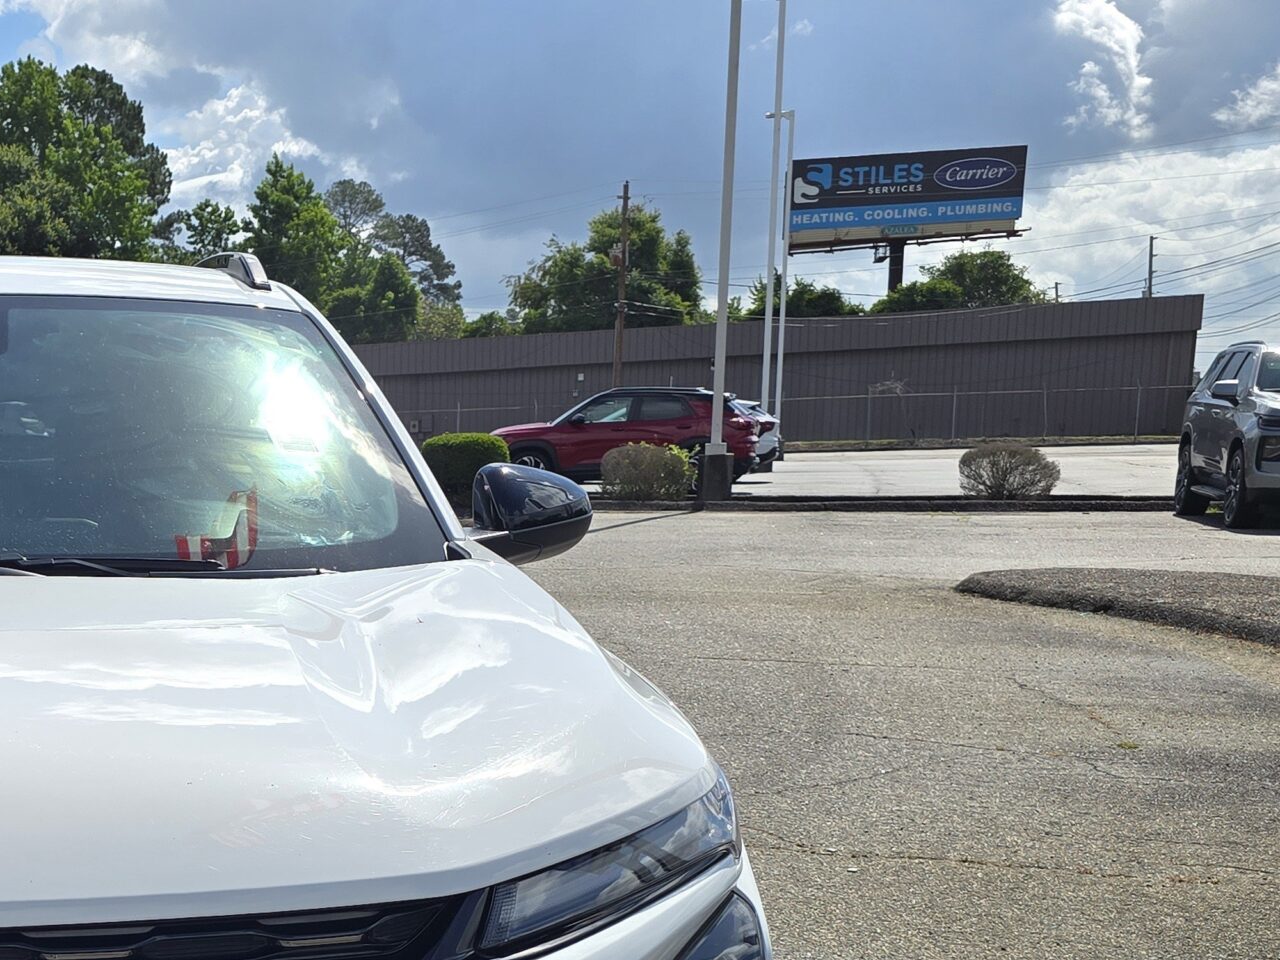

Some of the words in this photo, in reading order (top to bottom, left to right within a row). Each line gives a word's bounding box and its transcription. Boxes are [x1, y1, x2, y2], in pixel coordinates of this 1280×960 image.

[838, 163, 924, 187] STILES
[945, 165, 1007, 182] Carrier
[867, 184, 923, 195] SERVICES
[792, 212, 859, 225] HEATING.
[863, 207, 933, 220] COOLING.
[937, 202, 1017, 216] PLUMBING.
